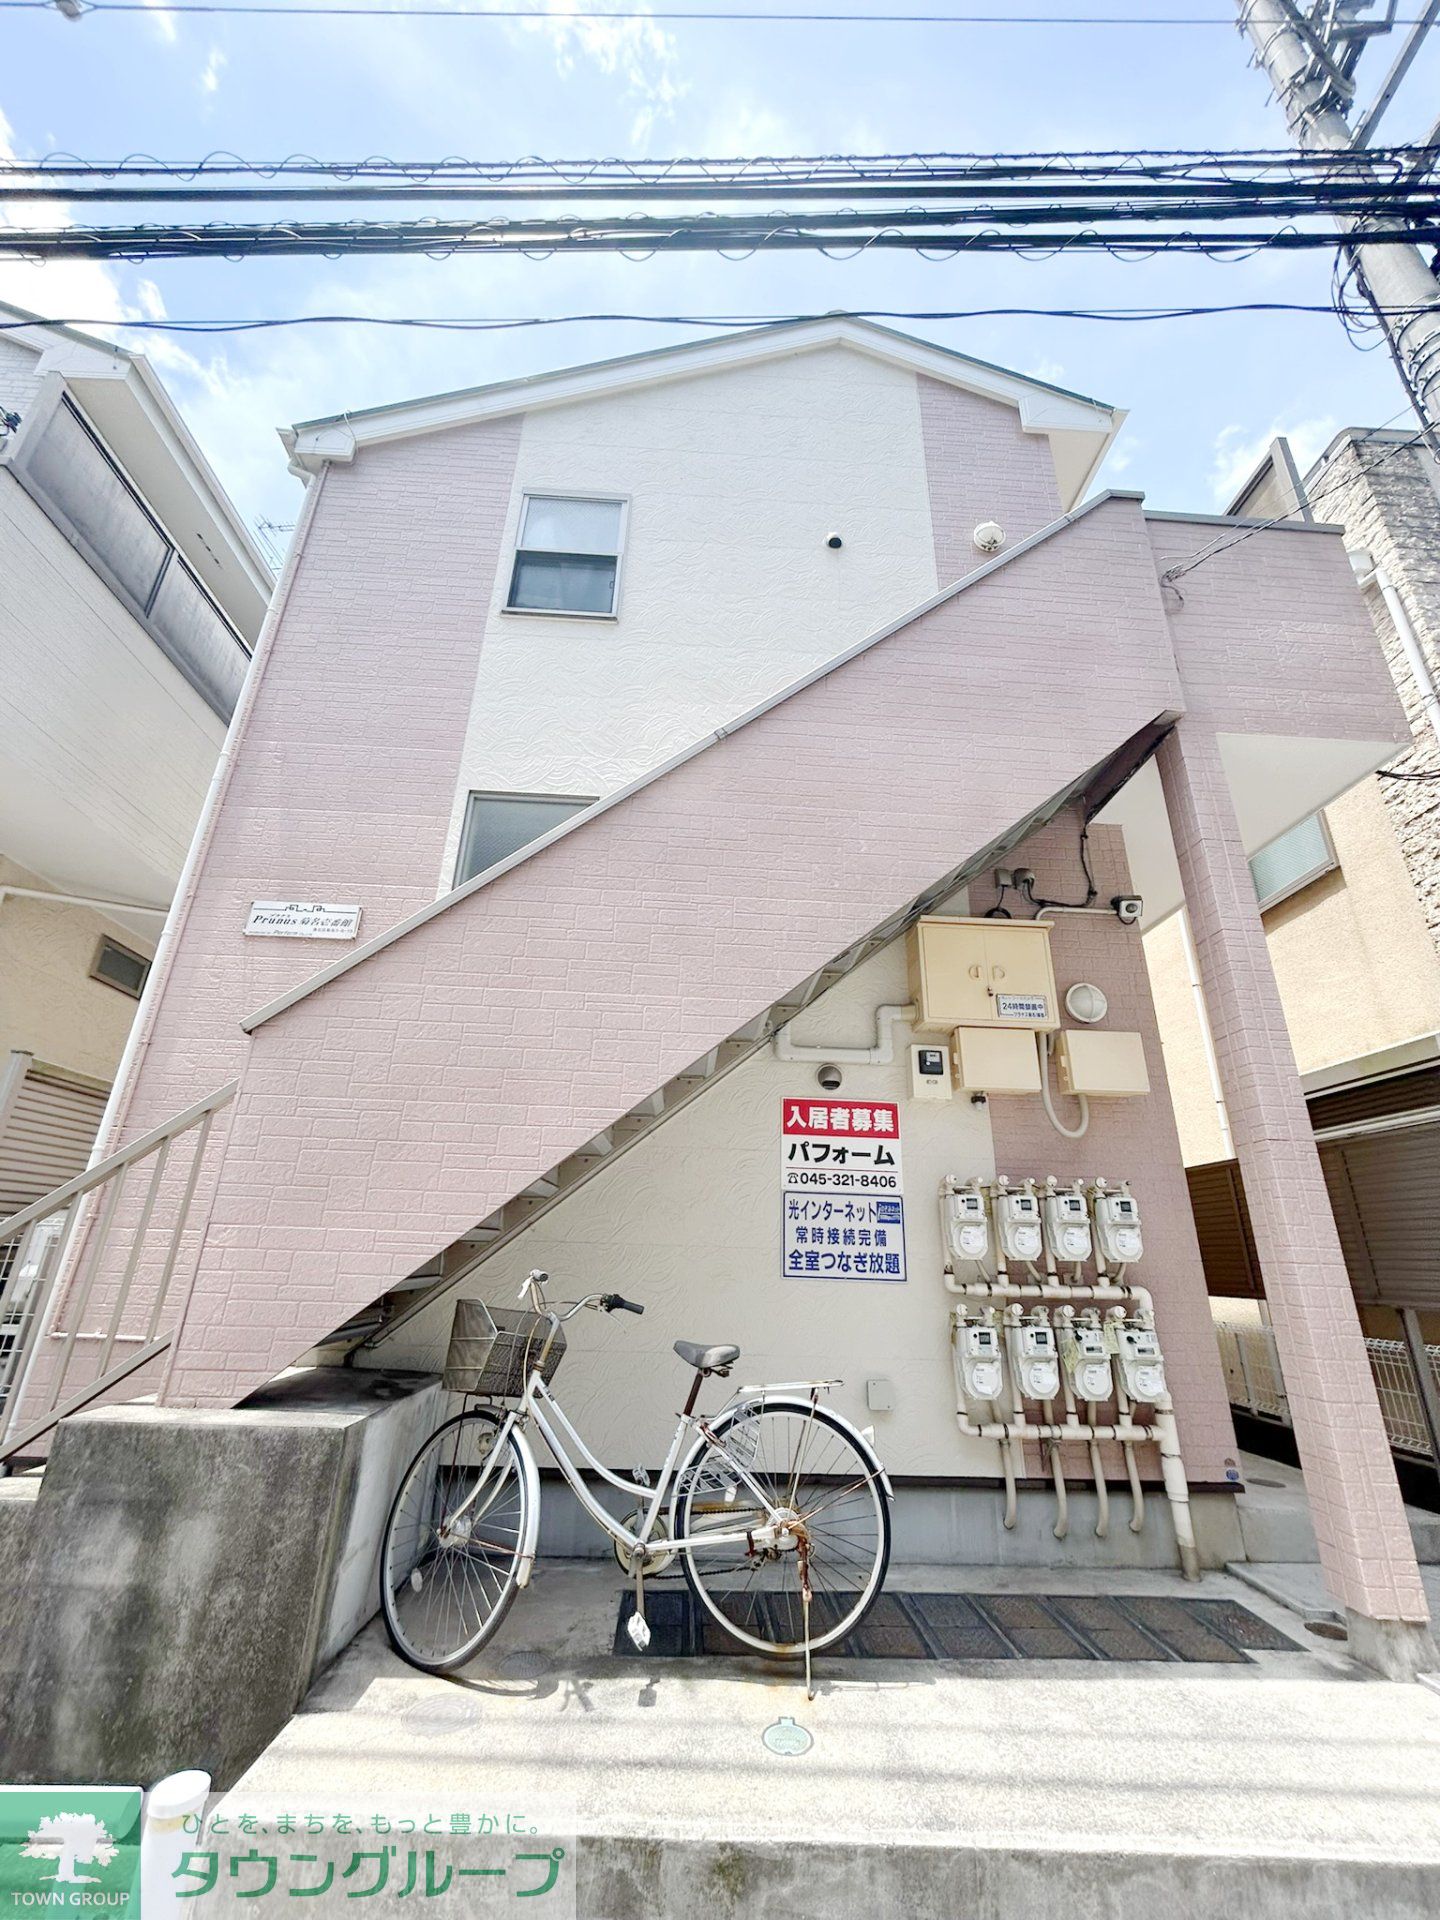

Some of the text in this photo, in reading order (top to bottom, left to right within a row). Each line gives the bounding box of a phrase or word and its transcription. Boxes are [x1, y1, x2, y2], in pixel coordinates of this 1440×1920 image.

[253, 915, 297, 925] Prunus
[787, 1105, 895, 1132] 入居者募集
[788, 1141, 896, 1167] パフォーム
[800, 1172, 897, 1188] 045-321-8406
[788, 1199, 877, 1224] 光インターネット
[795, 1226, 888, 1248] 常時接続完備
[788, 1249, 901, 1275] 全室つなぎ放題
